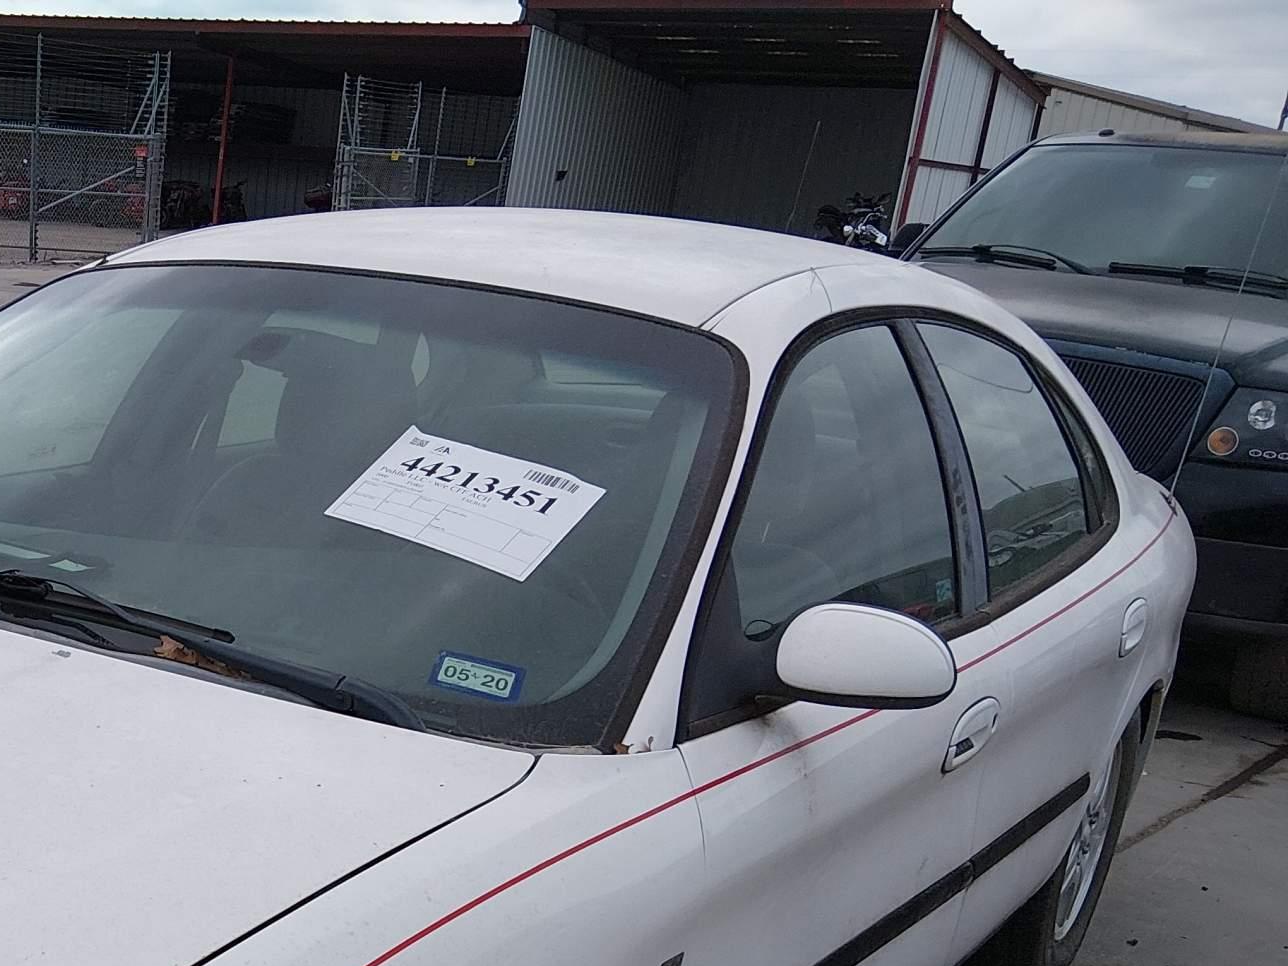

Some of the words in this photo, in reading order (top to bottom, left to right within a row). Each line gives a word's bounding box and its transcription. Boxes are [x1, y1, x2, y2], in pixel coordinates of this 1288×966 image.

[400, 456, 559, 515] 44213451
[444, 665, 471, 681] 05
[480, 674, 509, 691] 20
